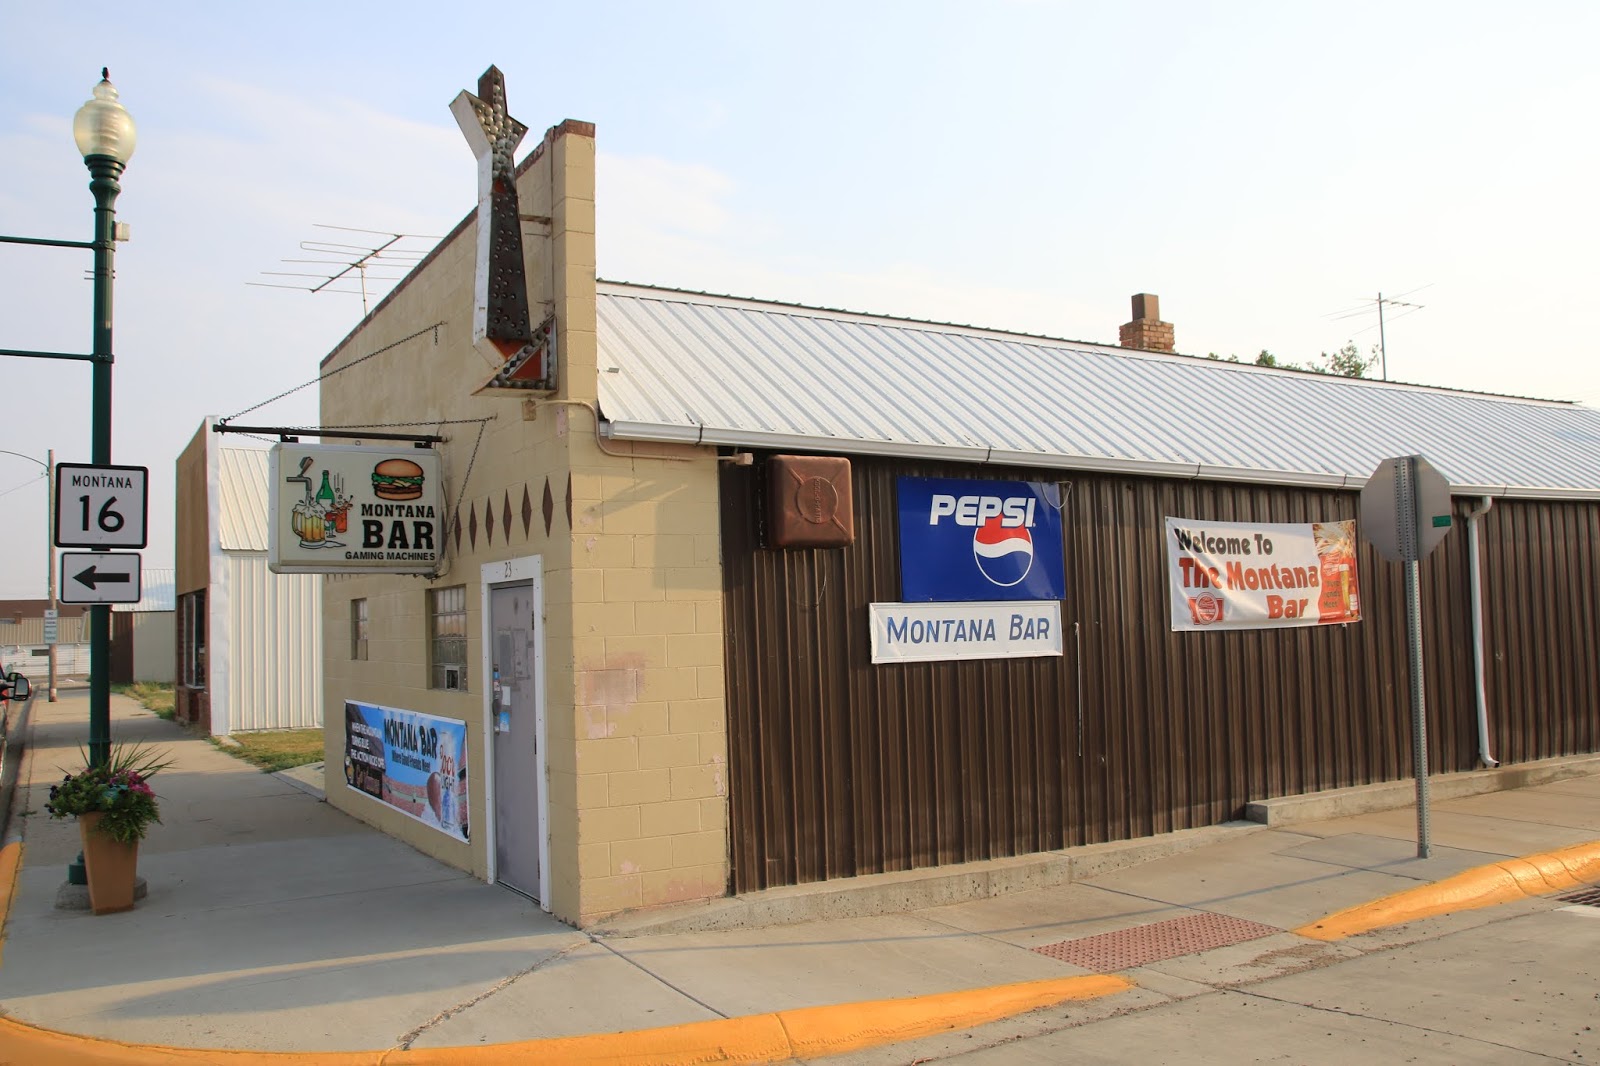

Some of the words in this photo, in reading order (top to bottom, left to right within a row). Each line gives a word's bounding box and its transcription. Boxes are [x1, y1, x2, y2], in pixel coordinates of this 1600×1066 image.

[72, 475, 132, 488] MONTANA
[79, 495, 124, 532] 16
[361, 503, 435, 518] MONTANA
[929, 494, 1036, 528] PEPSI
[362, 519, 434, 550] BAR
[1174, 528, 1250, 555] Welcome
[1254, 533, 1273, 555] To
[345, 551, 384, 560] GAMING
[386, 552, 435, 561] MACHINES
[504, 561, 513, 578] 23
[1179, 557, 1223, 590] The
[1225, 561, 1320, 591] Montana
[1266, 594, 1309, 620] Bar
[886, 615, 996, 644] MONTANA
[384, 718, 418, 753] MONTANA
[419, 725, 438, 760] BAR
